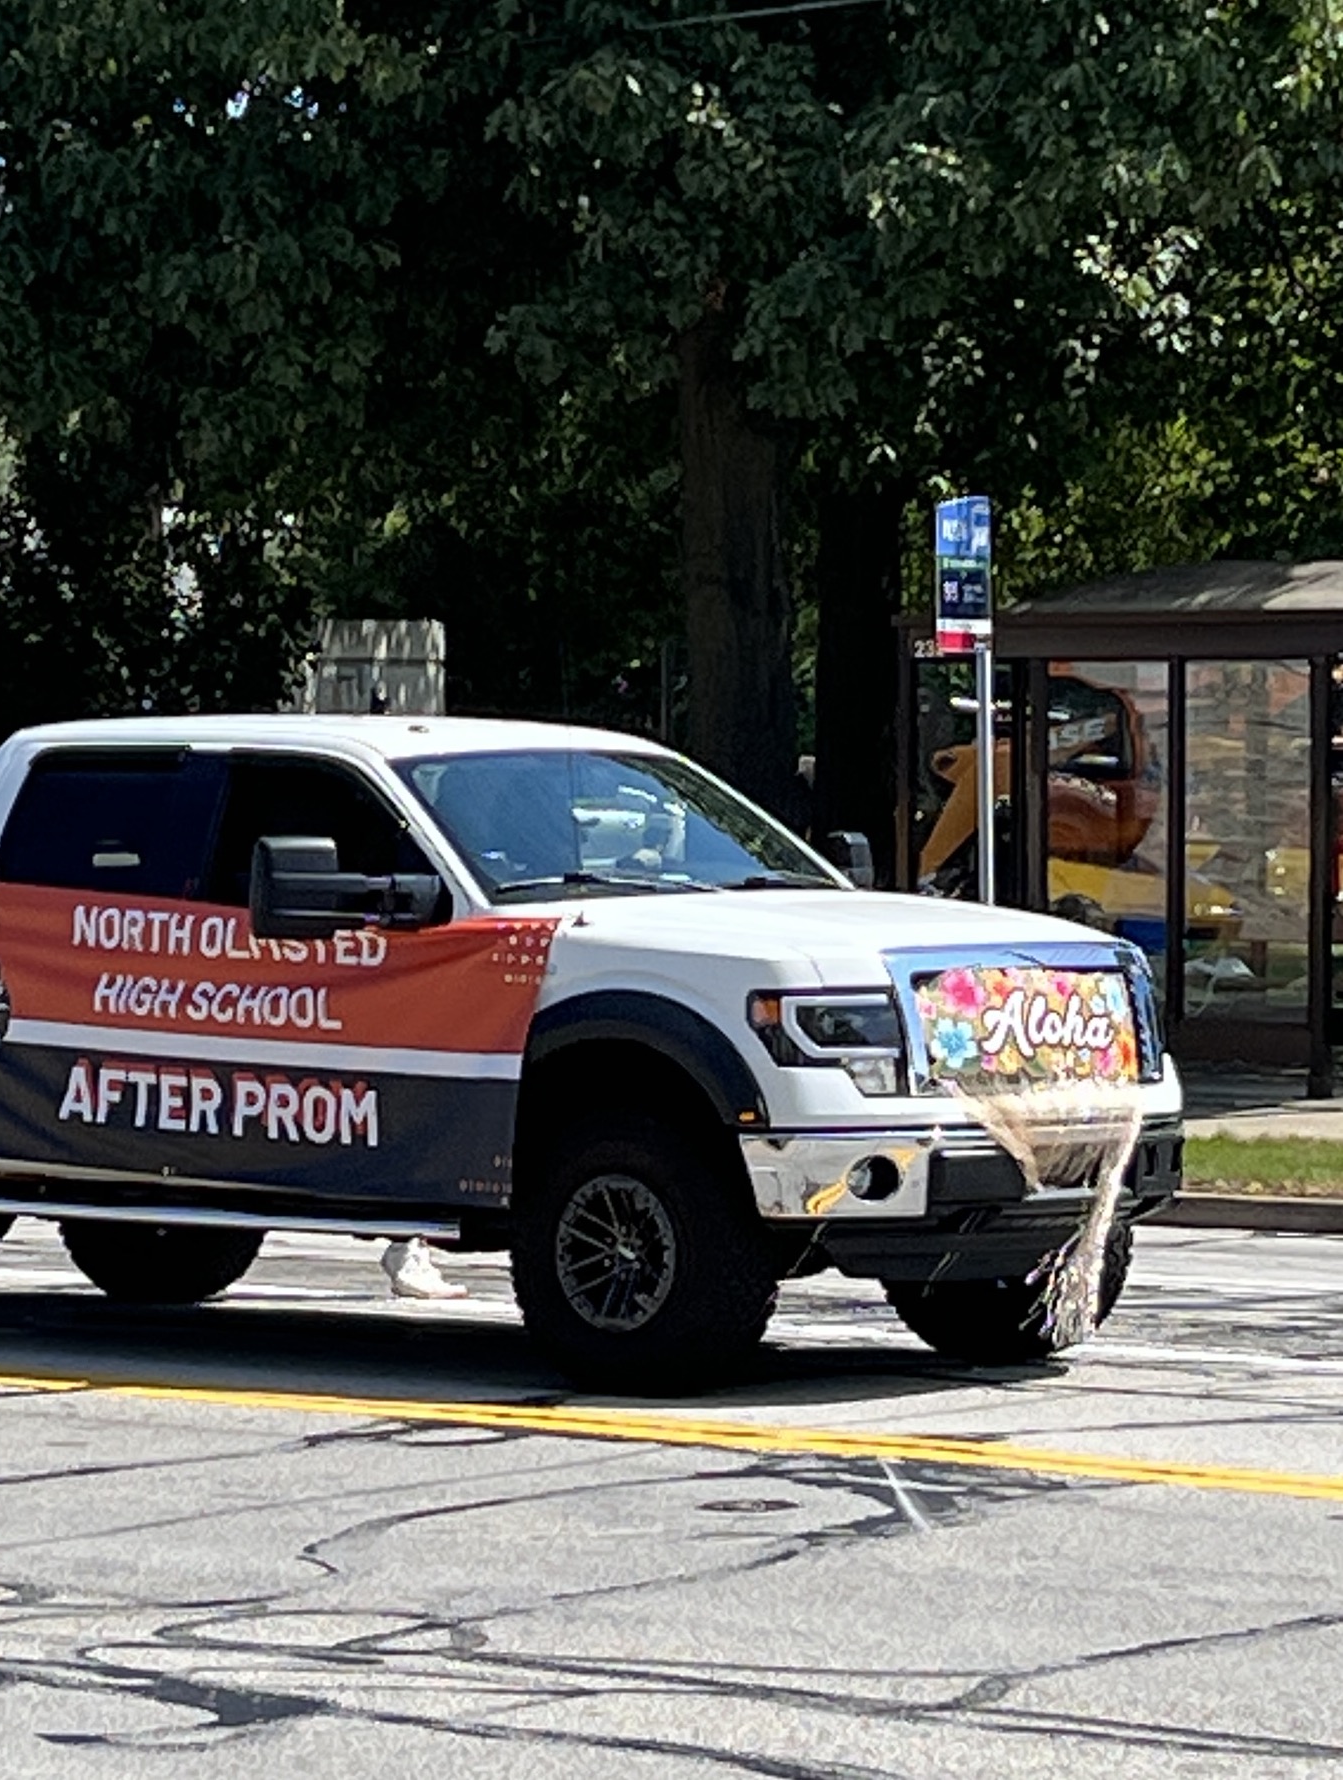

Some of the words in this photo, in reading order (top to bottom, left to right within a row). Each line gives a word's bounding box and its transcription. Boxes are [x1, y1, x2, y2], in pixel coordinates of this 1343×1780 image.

[72, 905, 196, 956] NORTH
[93, 972, 187, 1020] HIGH
[187, 981, 343, 1031] SCHOOL
[980, 988, 1115, 1058] Aloha
[58, 1062, 223, 1136] AFTER
[231, 1077, 379, 1148] PROM
